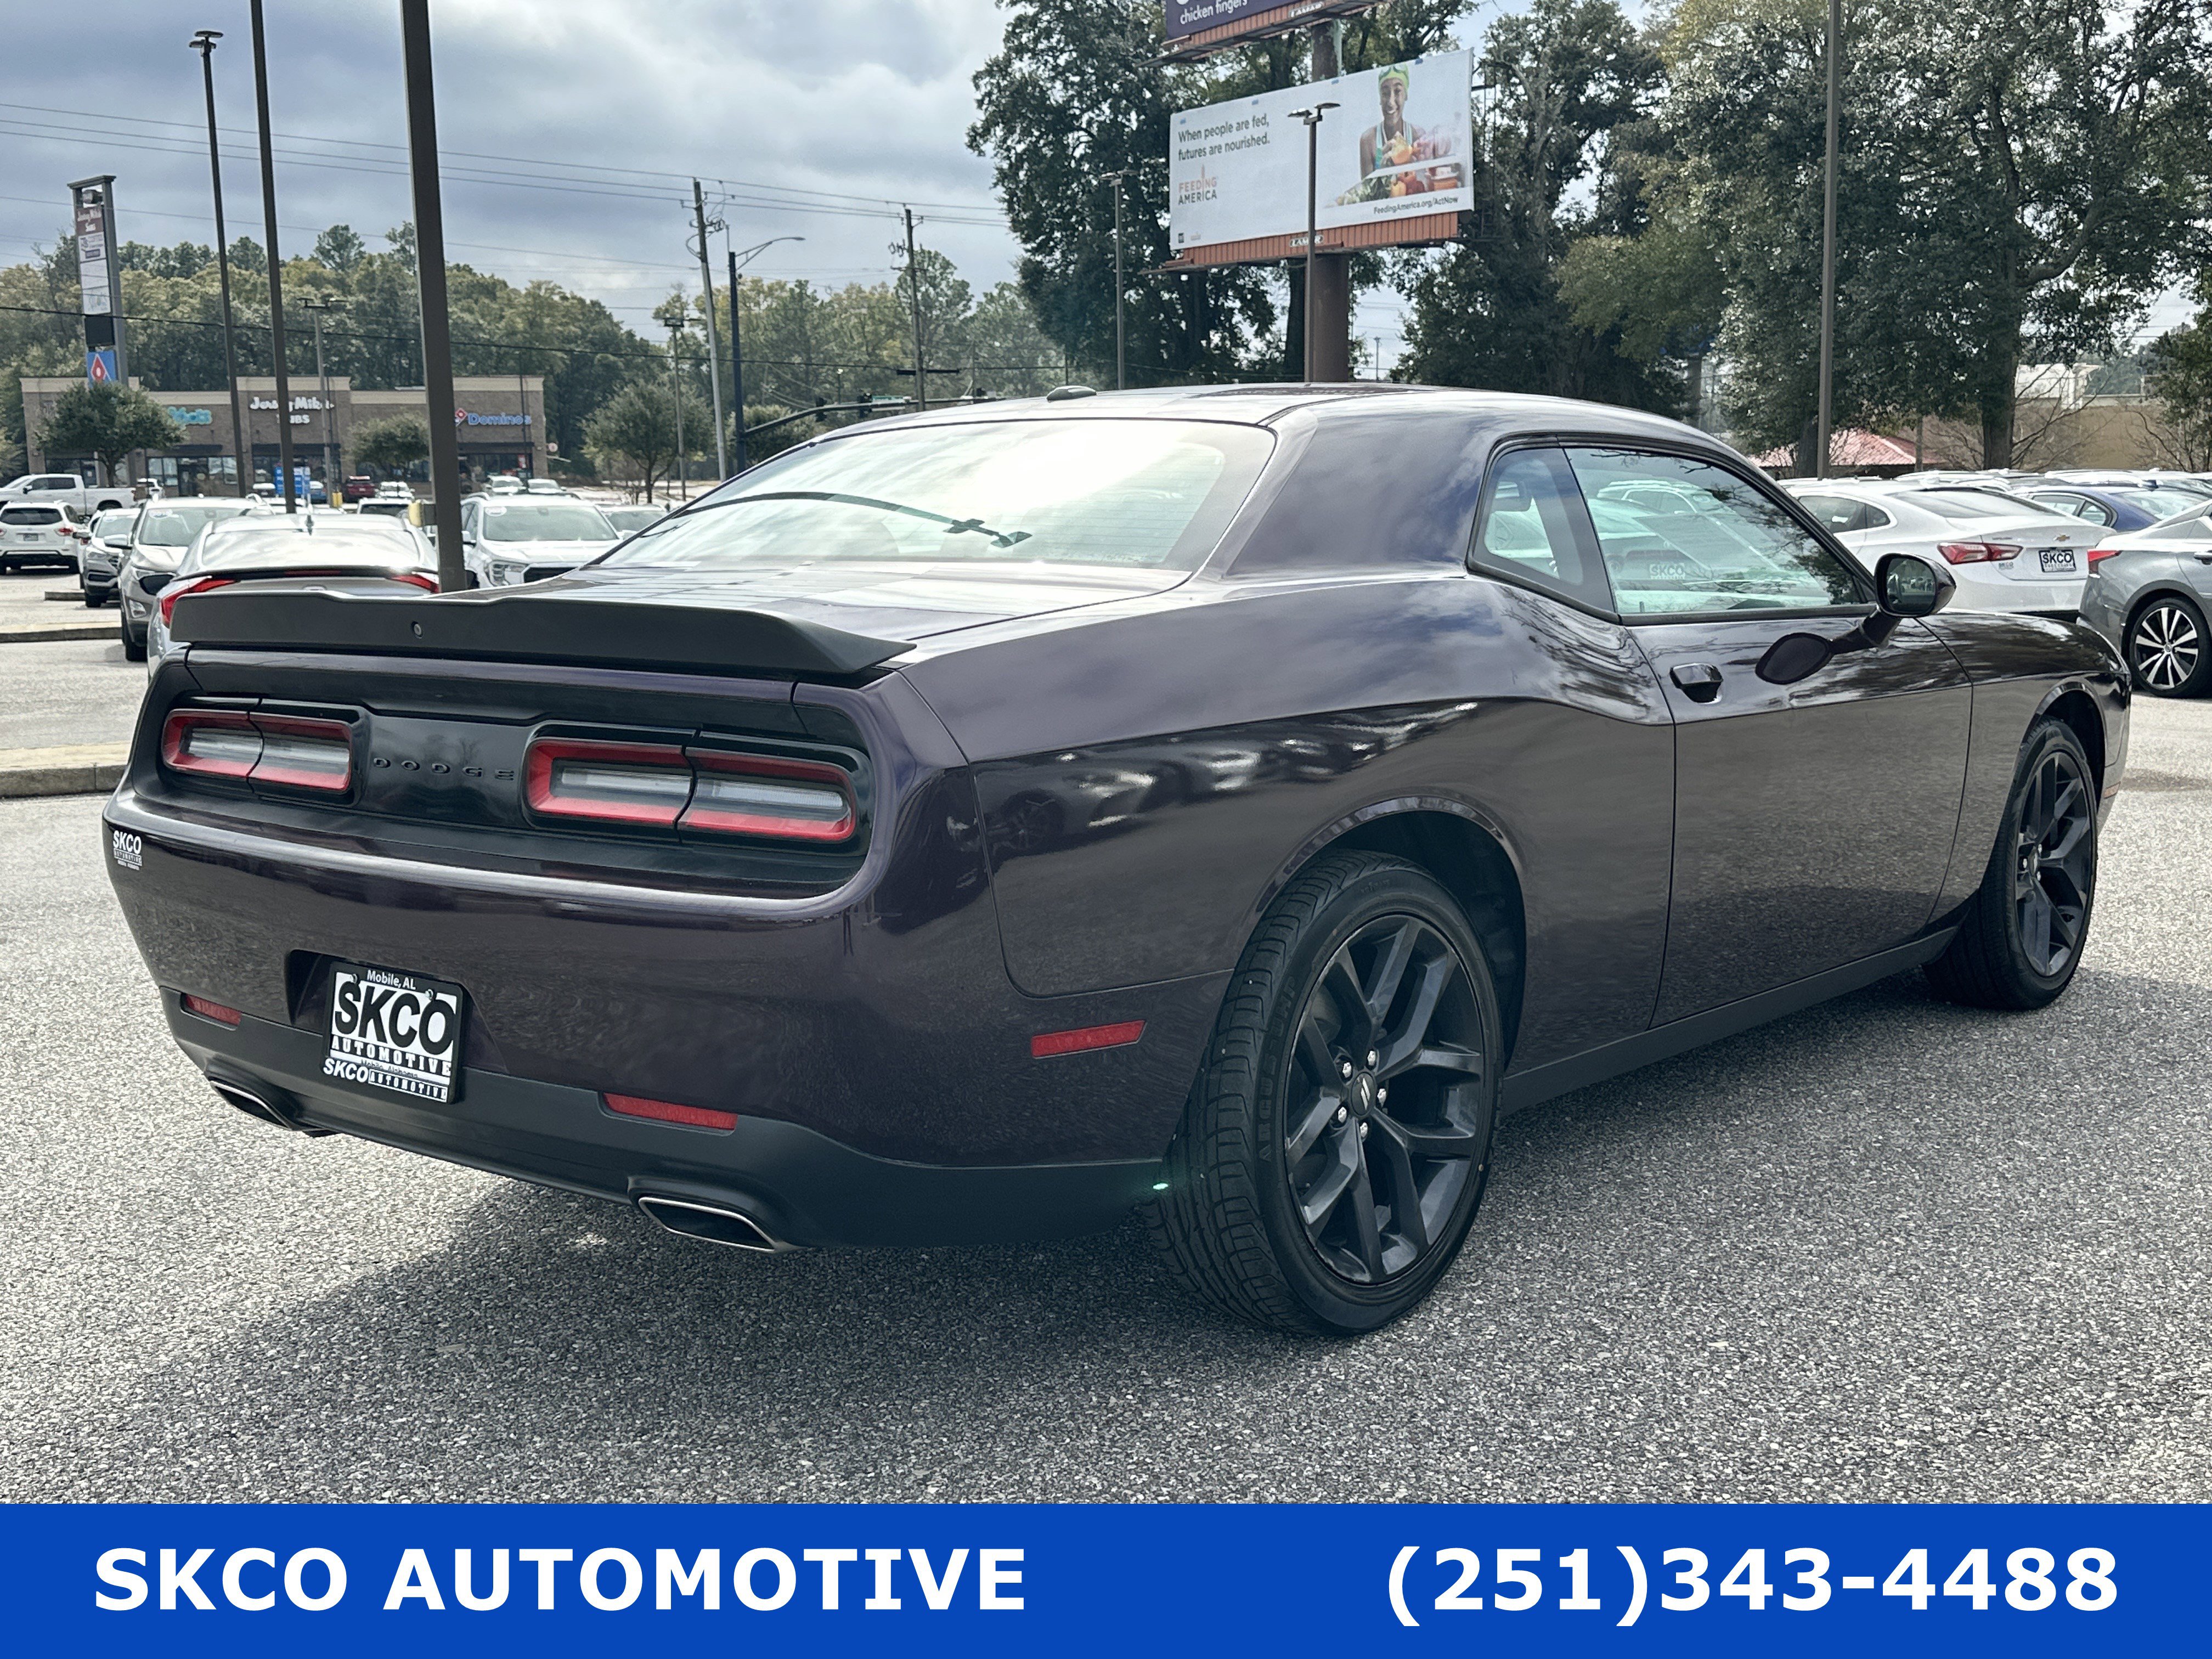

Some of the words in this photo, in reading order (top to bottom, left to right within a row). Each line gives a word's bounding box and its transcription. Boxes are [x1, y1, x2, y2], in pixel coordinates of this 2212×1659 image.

[1180, 5, 1214, 24] chicken
[1178, 129, 1202, 143] When
[1204, 121, 1233, 140] people
[1235, 119, 1250, 132] are
[1252, 113, 1269, 128] fed,
[1178, 146, 1207, 161] futures
[1209, 144, 1222, 156] are
[1224, 132, 1270, 153] nourished.
[1178, 177, 1217, 192] FEEDING
[1178, 189, 1217, 205] AMERICA
[2042, 552, 2073, 564] SKCO
[373, 757, 515, 781] DODGE
[112, 830, 142, 855] SKCO
[366, 969, 402, 989] Mobile,
[402, 977, 416, 990] AL
[335, 980, 456, 1055] SKCO
[331, 1035, 452, 1076] AUTOMOTIVE
[323, 1058, 368, 1083] SKCO
[370, 1072, 447, 1101] AUTOMOTIVE
